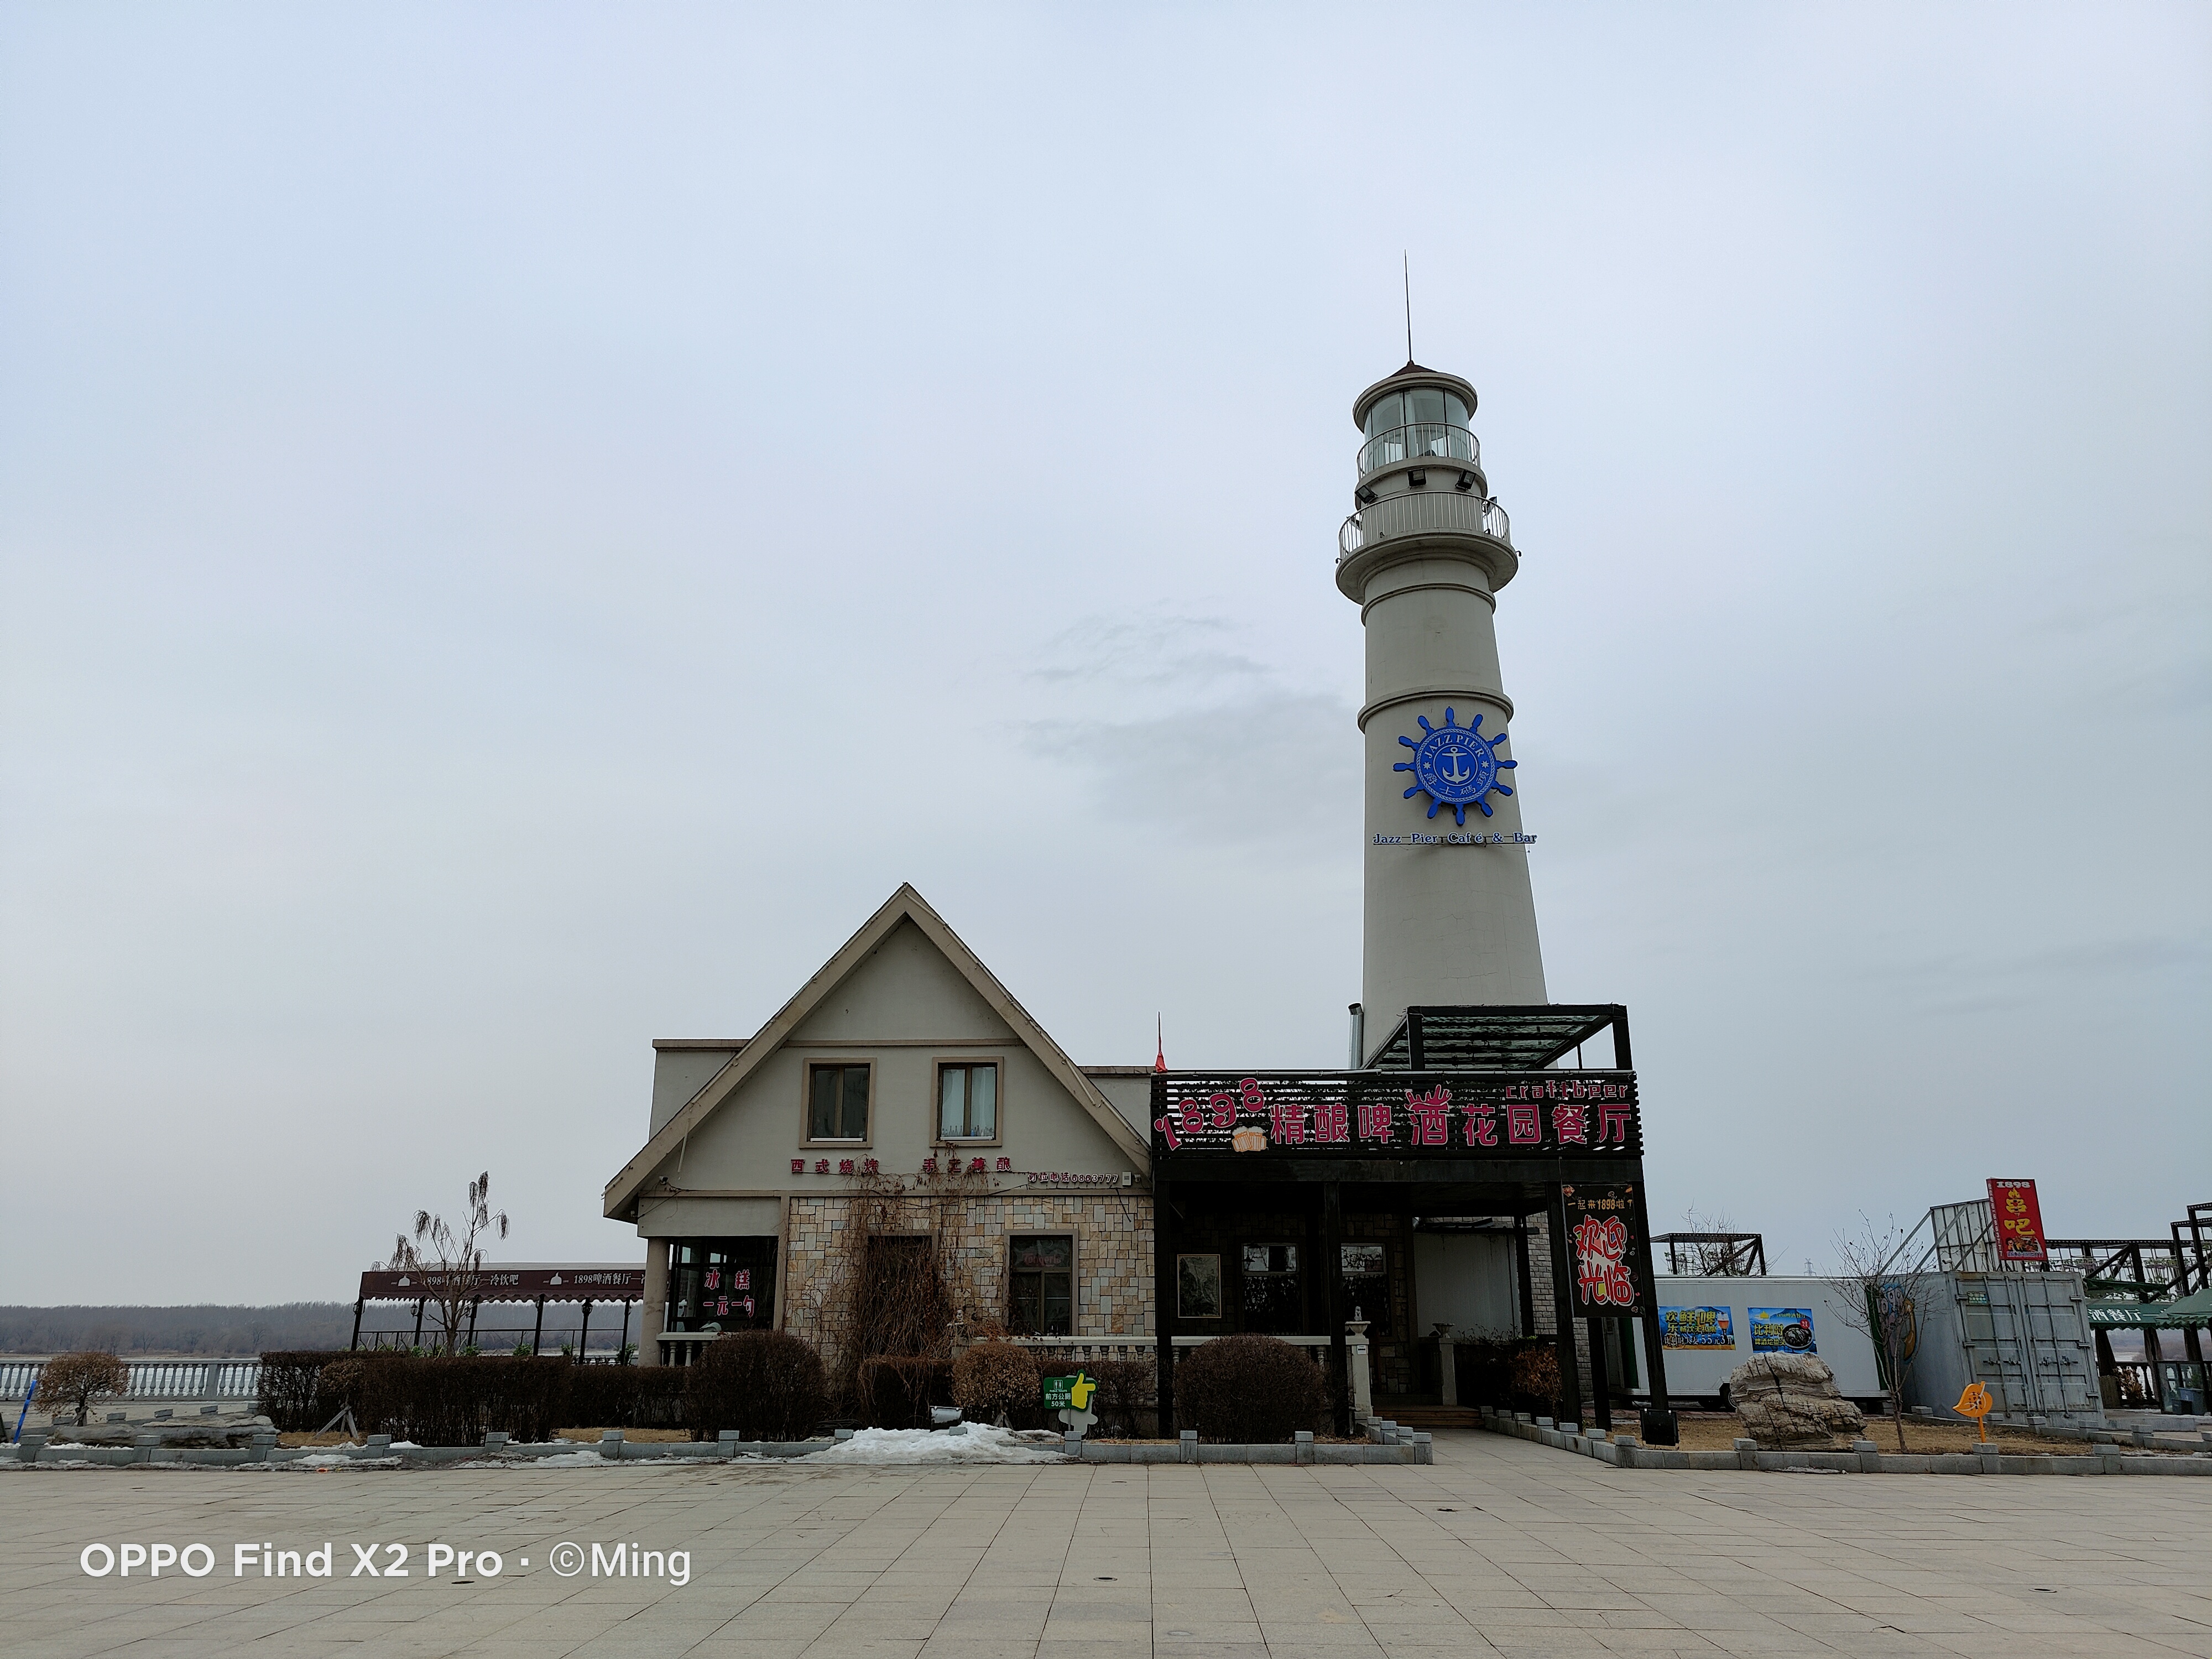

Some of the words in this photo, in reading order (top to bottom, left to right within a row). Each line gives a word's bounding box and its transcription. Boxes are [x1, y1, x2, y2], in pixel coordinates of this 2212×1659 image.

[1424, 734, 1453, 759] JAZZ
[1455, 735, 1485, 758] PIER
[1373, 833, 1402, 844] Jazz
[1411, 833, 1438, 843] Pier
[1447, 832, 1484, 843] Café
[1492, 832, 1504, 843] &
[1512, 832, 1538, 843] Bar
[1505, 1079, 1628, 1099] craftbeer
[1754, 1323, 1784, 1336] 比利时
